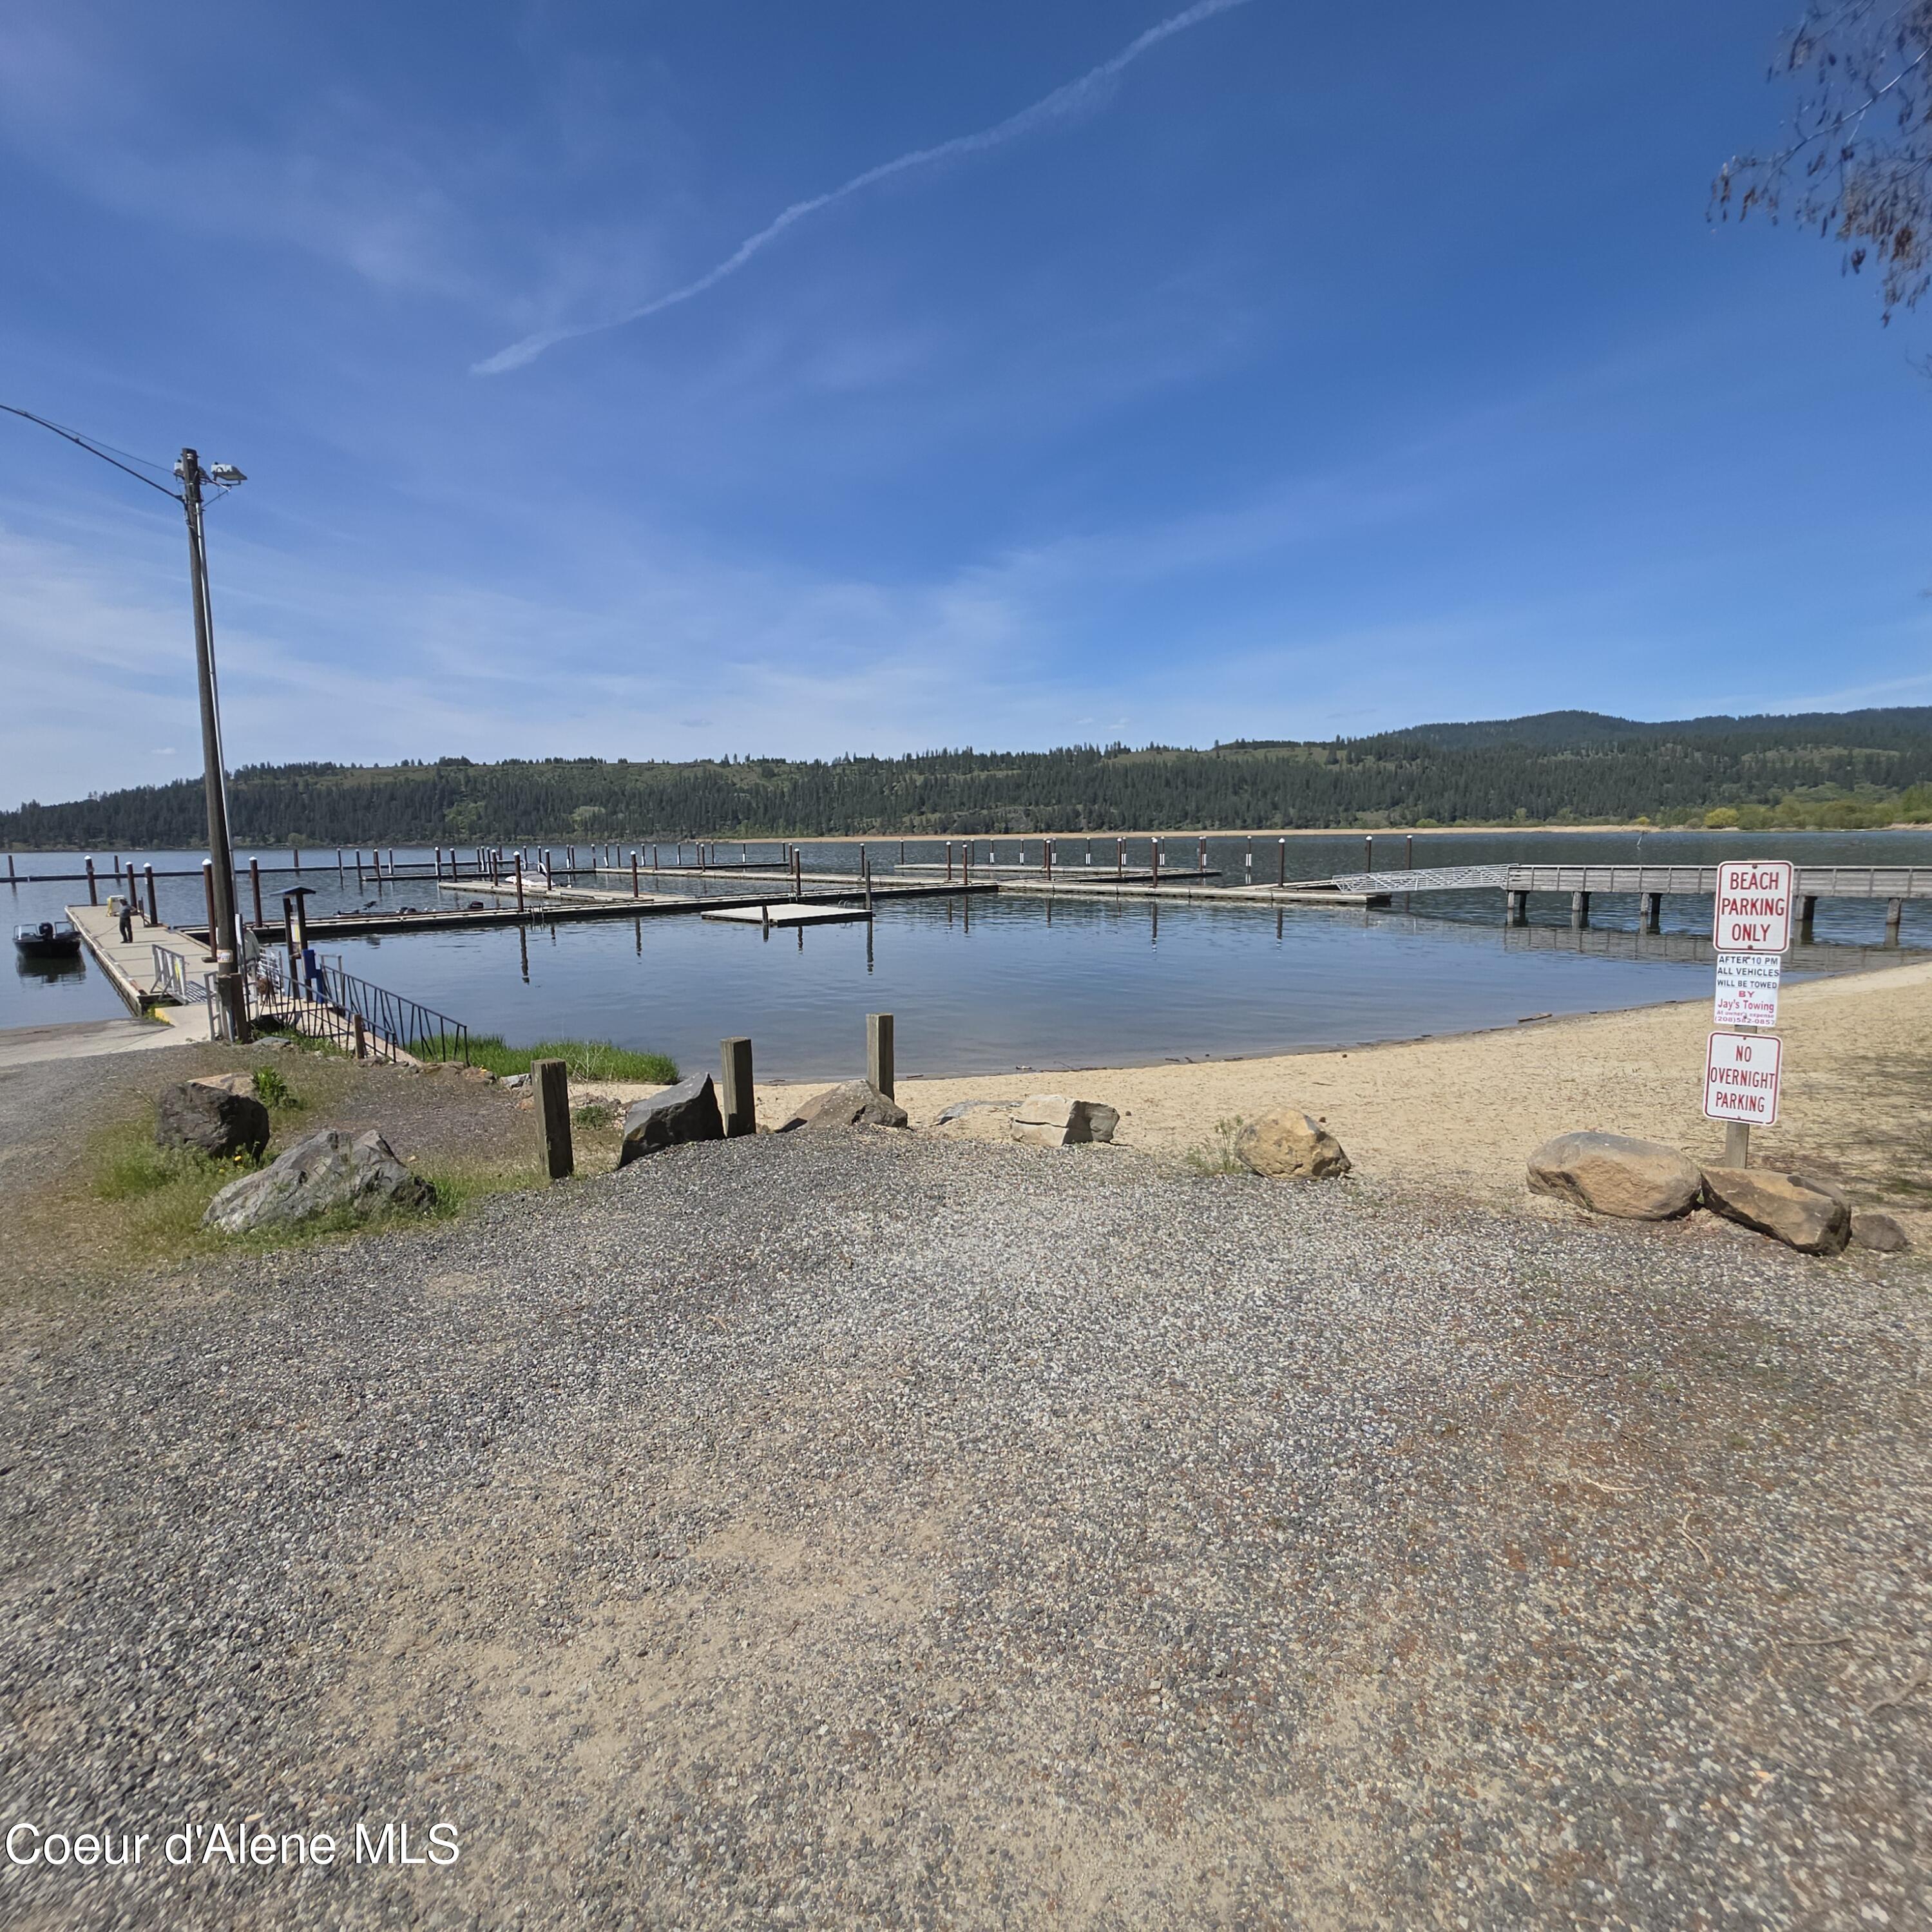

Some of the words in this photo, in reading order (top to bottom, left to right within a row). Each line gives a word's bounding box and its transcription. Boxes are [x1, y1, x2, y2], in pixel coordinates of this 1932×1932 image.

[1730, 872, 1779, 890] BEACH
[1721, 898, 1784, 915] PARKING
[1732, 923, 1771, 941] ONLY
[1736, 968, 1779, 977] VEHICLES
[1717, 999, 1739, 1010] Jay's
[1743, 1000, 1774, 1013] Towing
[1736, 1045, 1752, 1062] NO
[1710, 1067, 1775, 1089] OVERNIGHT
[1716, 1091, 1765, 1113] PARKING
